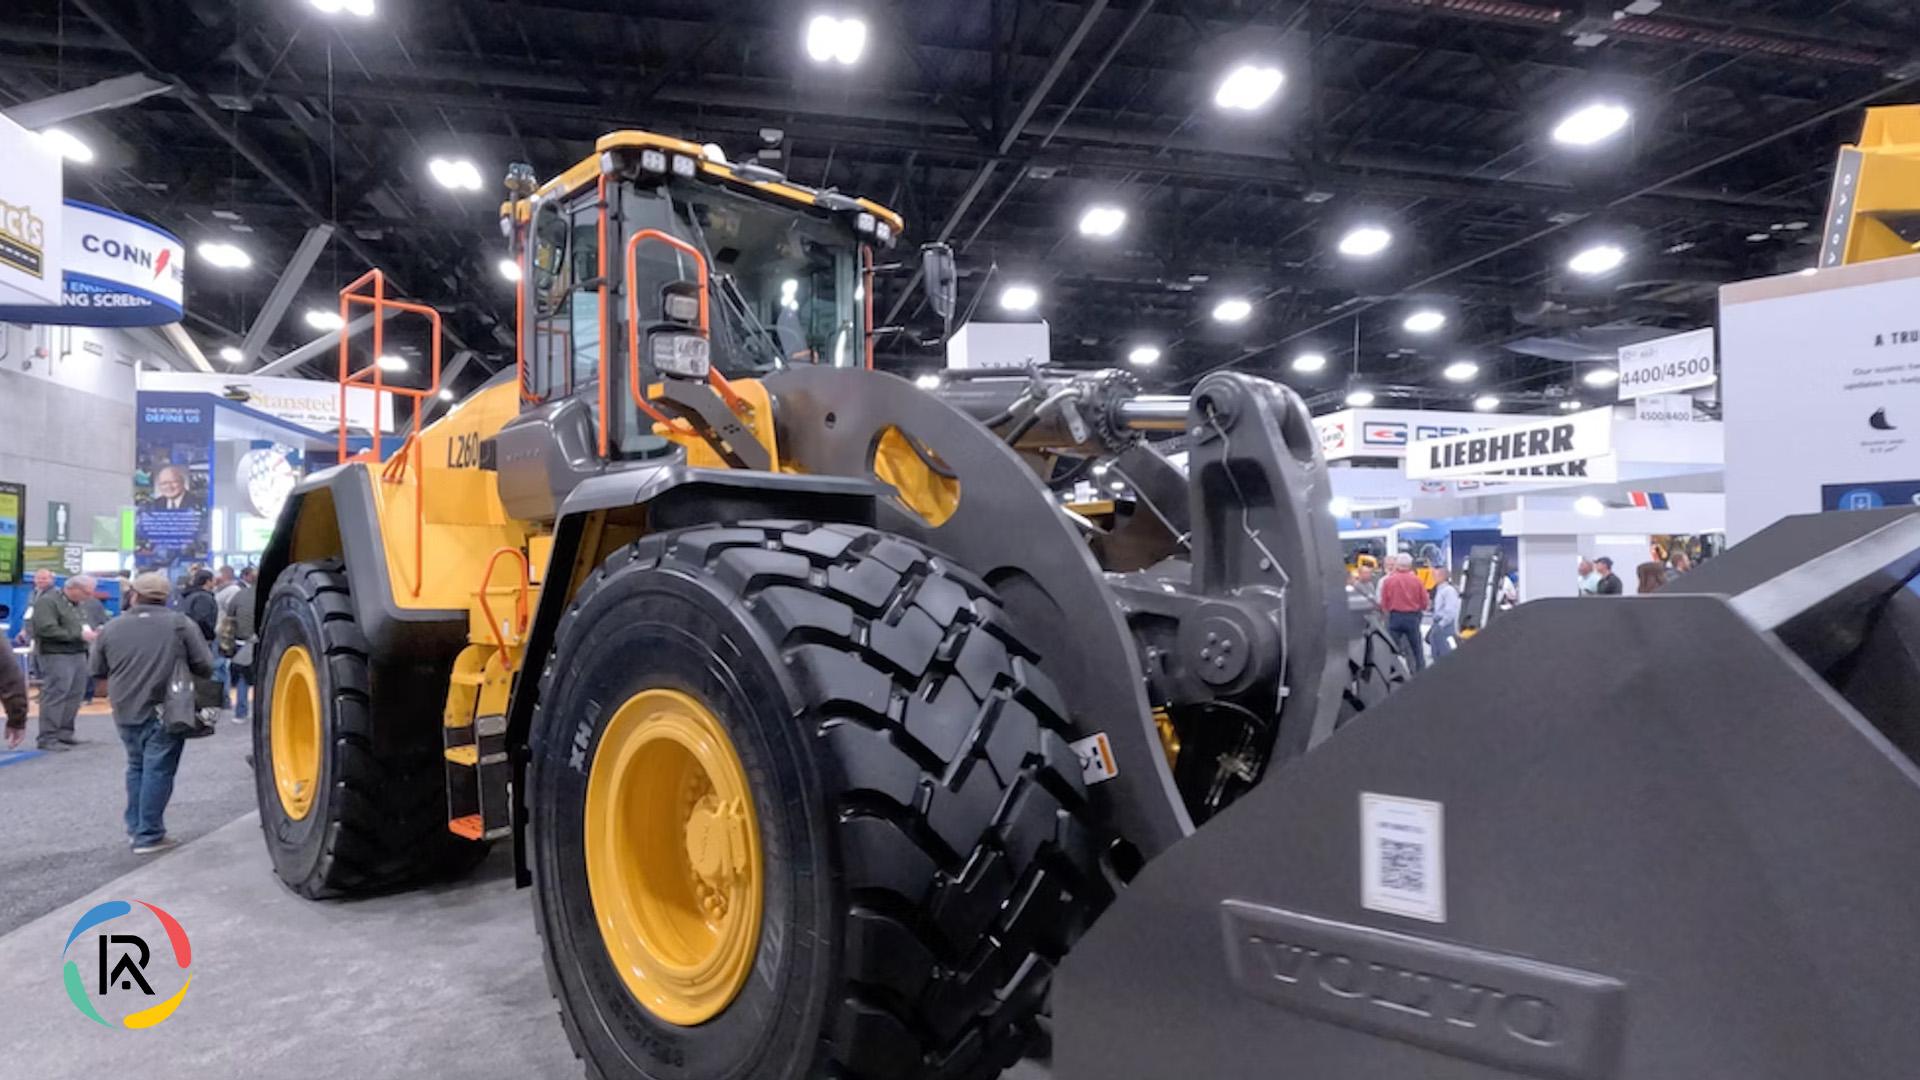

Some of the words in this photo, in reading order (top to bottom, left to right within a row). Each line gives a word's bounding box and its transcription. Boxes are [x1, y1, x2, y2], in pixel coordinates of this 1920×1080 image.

[1828, 174, 1851, 264] VOLVO
[82, 234, 152, 268] CONN
[1874, 333, 1884, 346] A
[1621, 356, 1710, 387] 4400/4500
[250, 387, 337, 413] Stansteel
[145, 413, 184, 423] DEFINE
[186, 414, 201, 424] US
[448, 431, 479, 468] L260
[1430, 423, 1576, 469] LIEBHERR
[1249, 936, 1562, 1047] VOLVO
